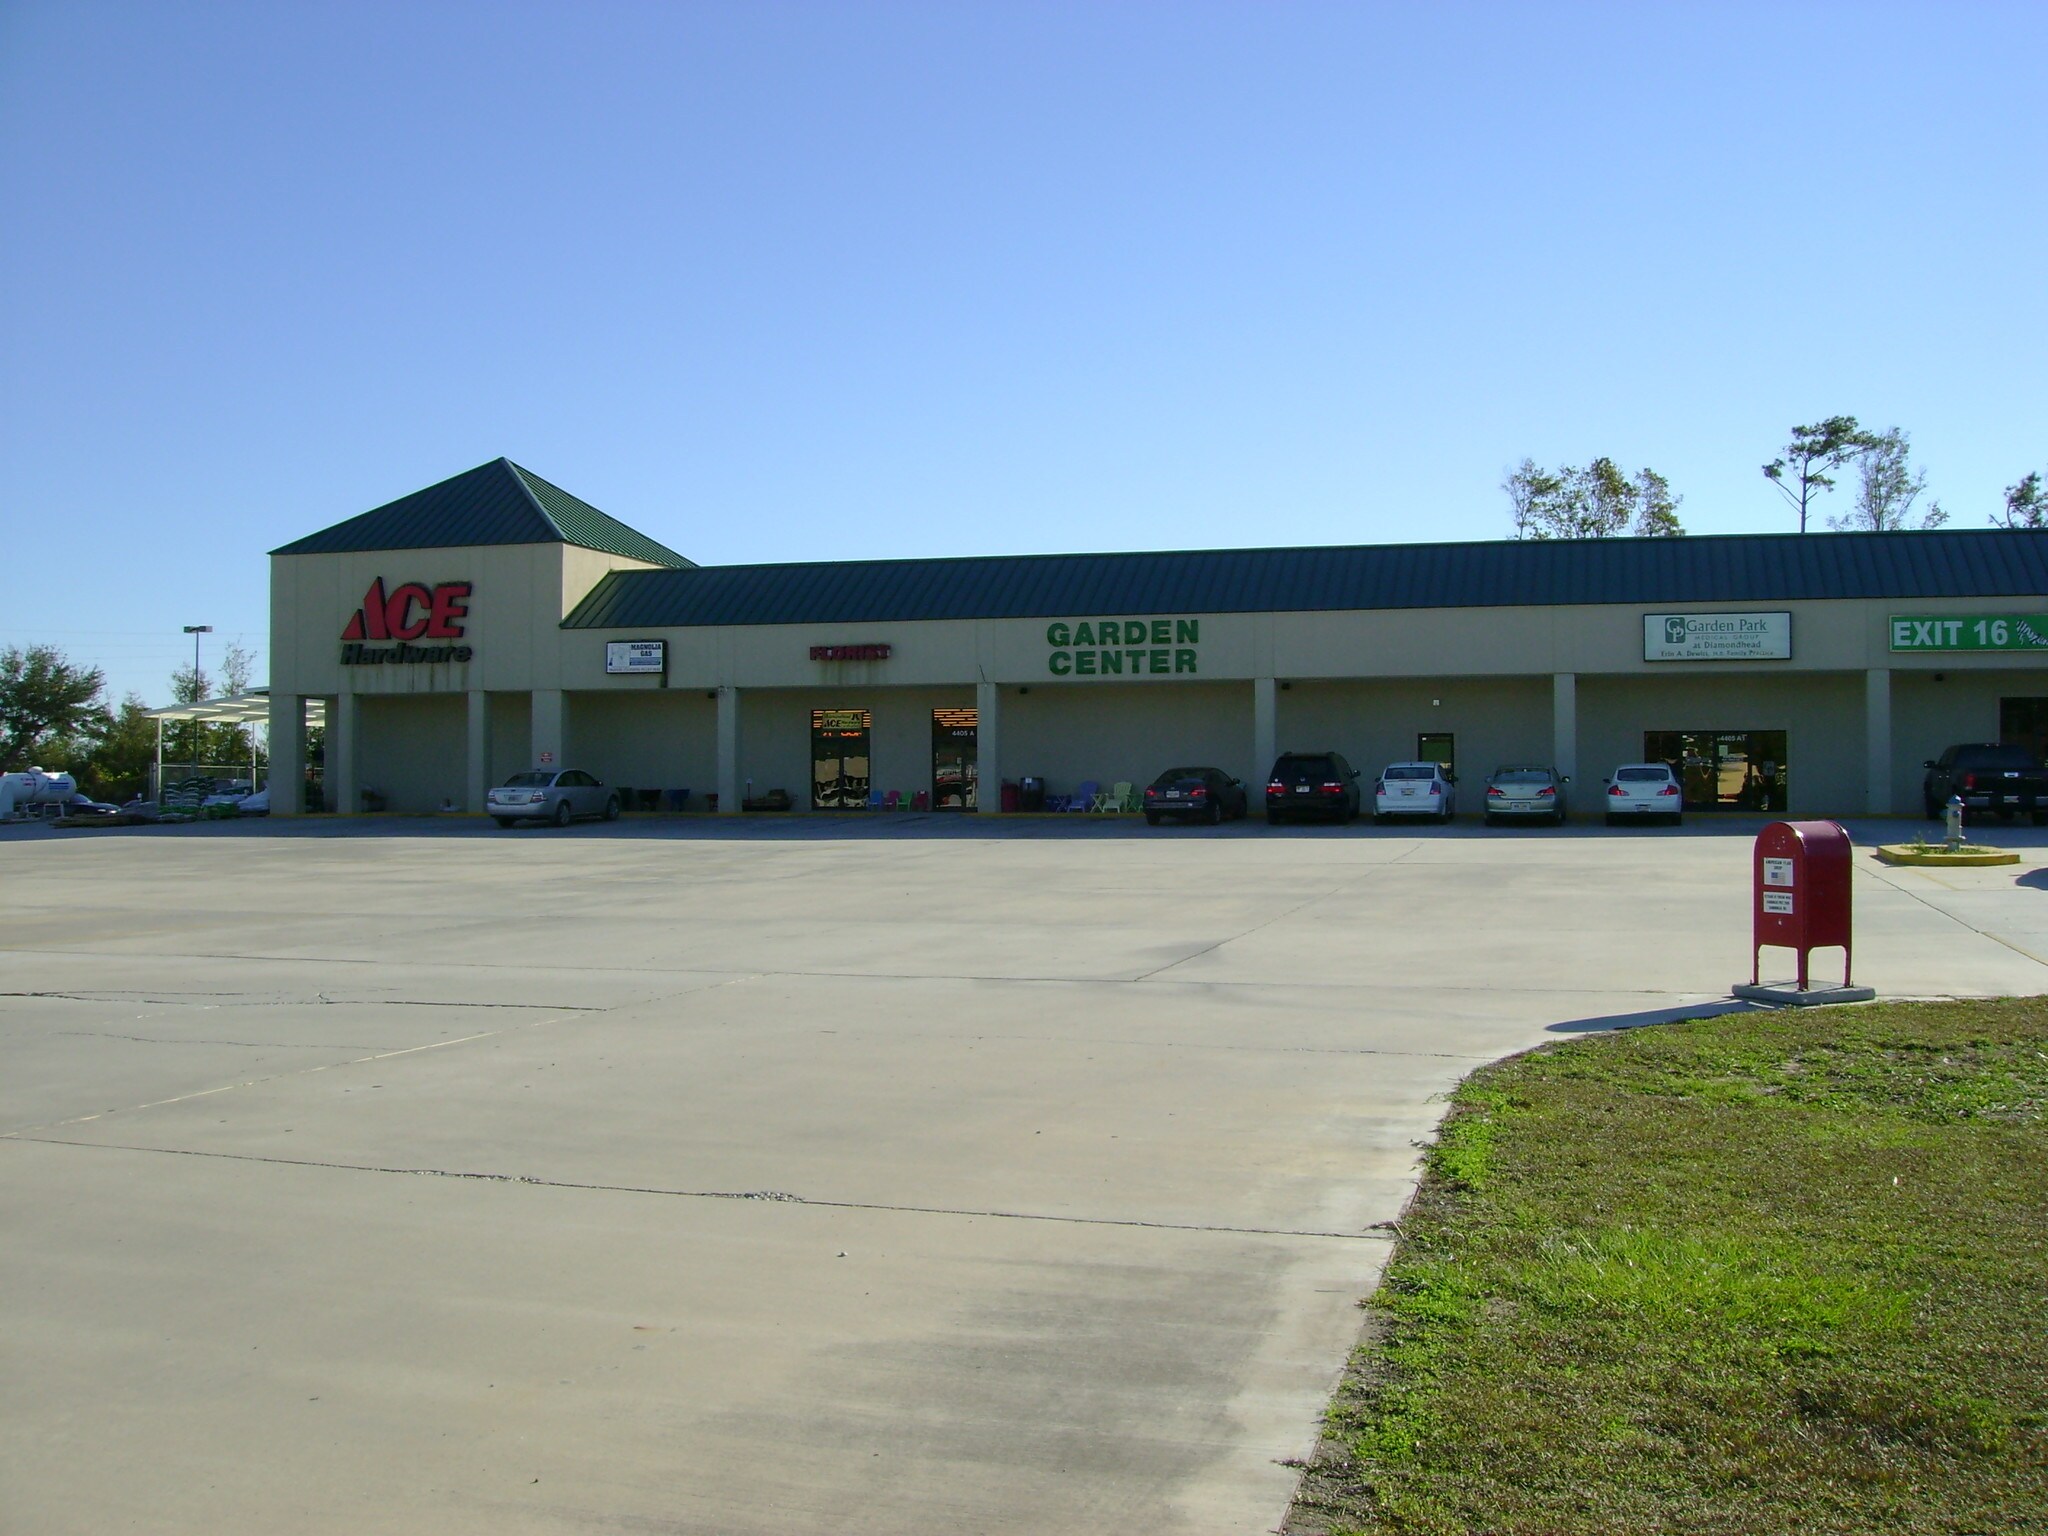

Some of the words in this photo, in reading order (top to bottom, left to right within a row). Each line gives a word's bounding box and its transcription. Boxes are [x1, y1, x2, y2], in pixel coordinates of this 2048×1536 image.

[341, 576, 473, 640] ACE
[1047, 619, 1199, 647] GARDEN
[1686, 619, 1734, 632] Garden
[1739, 618, 1767, 632] Park
[1893, 620, 1963, 646] EXIT
[1973, 620, 2008, 646] 16
[340, 642, 473, 665] Hardware
[1704, 641, 1761, 649] Diamondhead
[1049, 649, 1197, 676] CENTER
[951, 729, 968, 737] 4405
[969, 729, 975, 737] A
